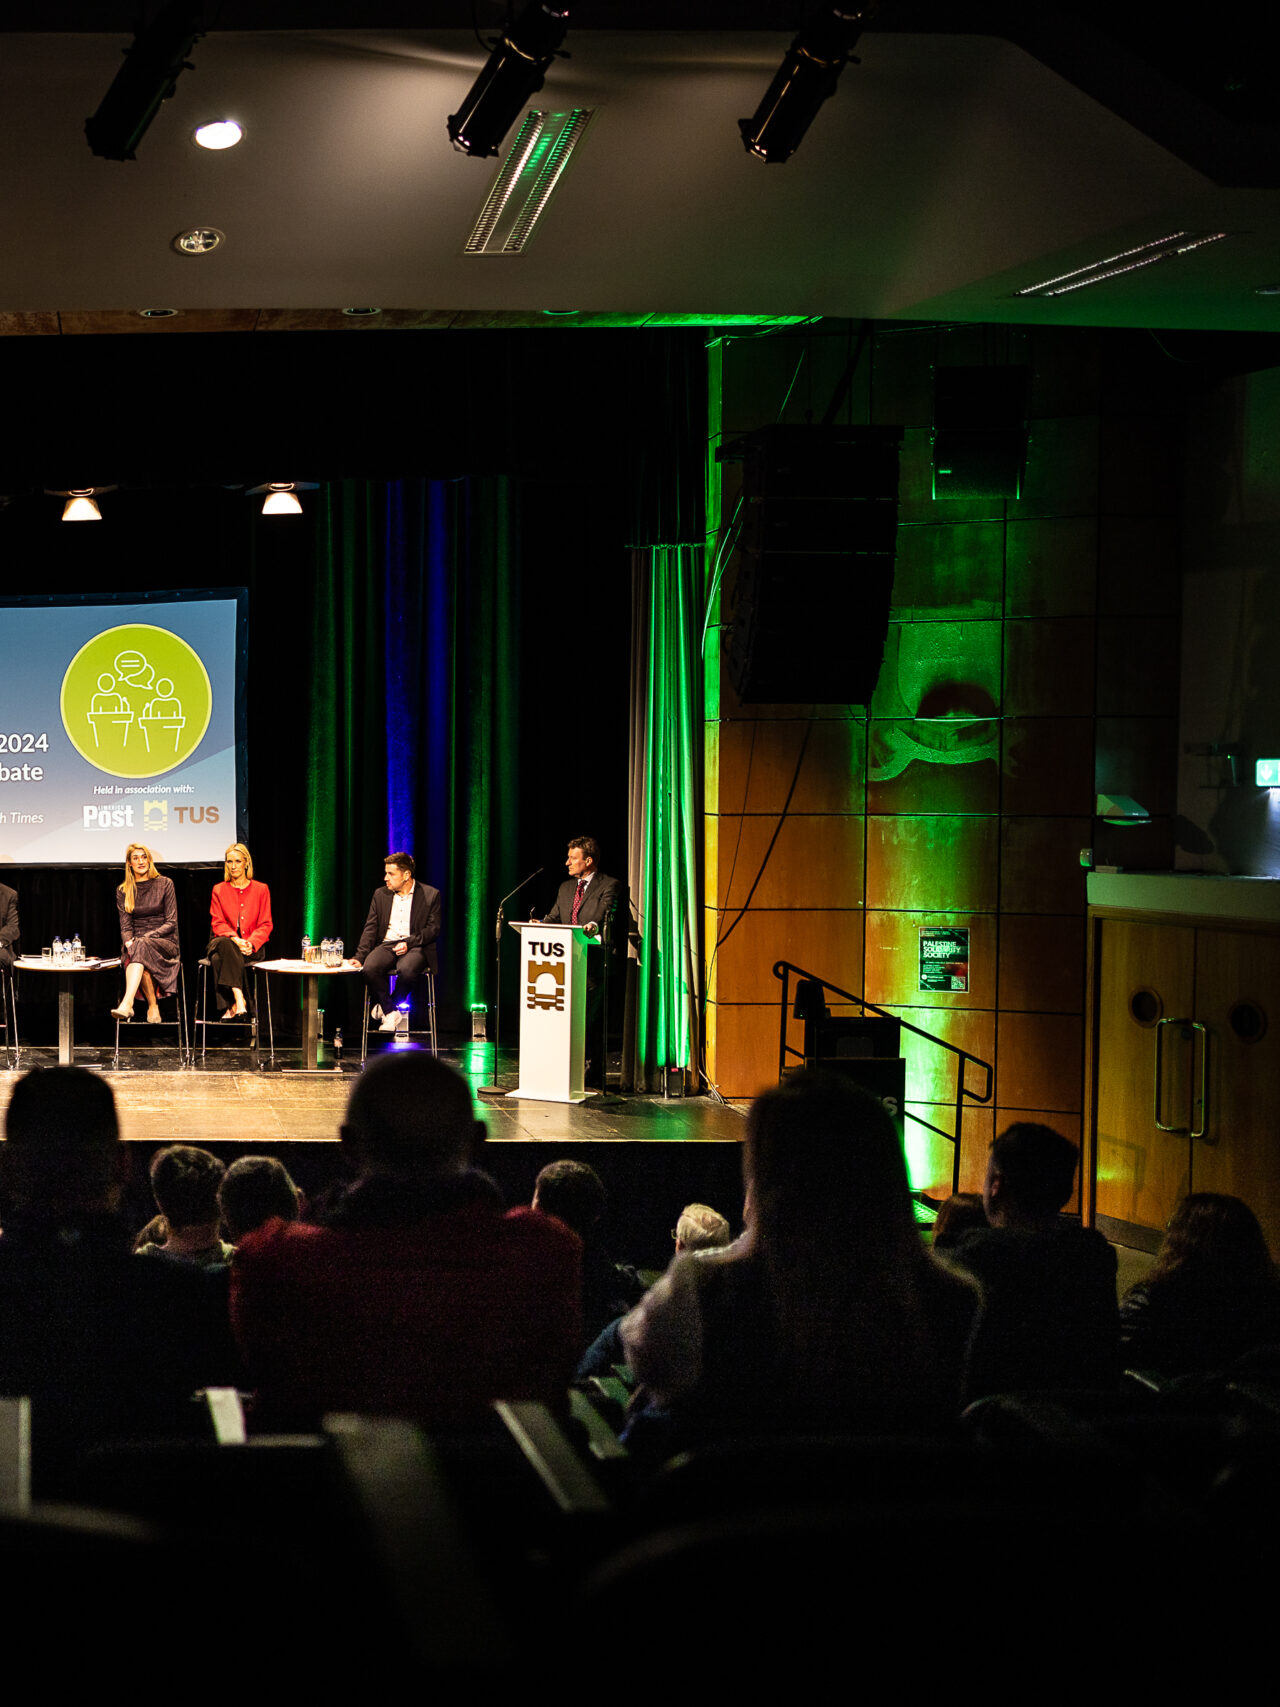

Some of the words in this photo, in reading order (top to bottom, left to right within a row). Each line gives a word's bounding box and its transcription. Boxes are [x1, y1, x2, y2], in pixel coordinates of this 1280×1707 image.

[93, 786, 113, 794] Held
[115, 785, 123, 794] in
[125, 785, 171, 794] association
[173, 784, 195, 793] with:
[10, 811, 44, 824] Times
[83, 805, 134, 828] Post
[174, 806, 220, 824] TUS
[528, 941, 565, 957] TUS
